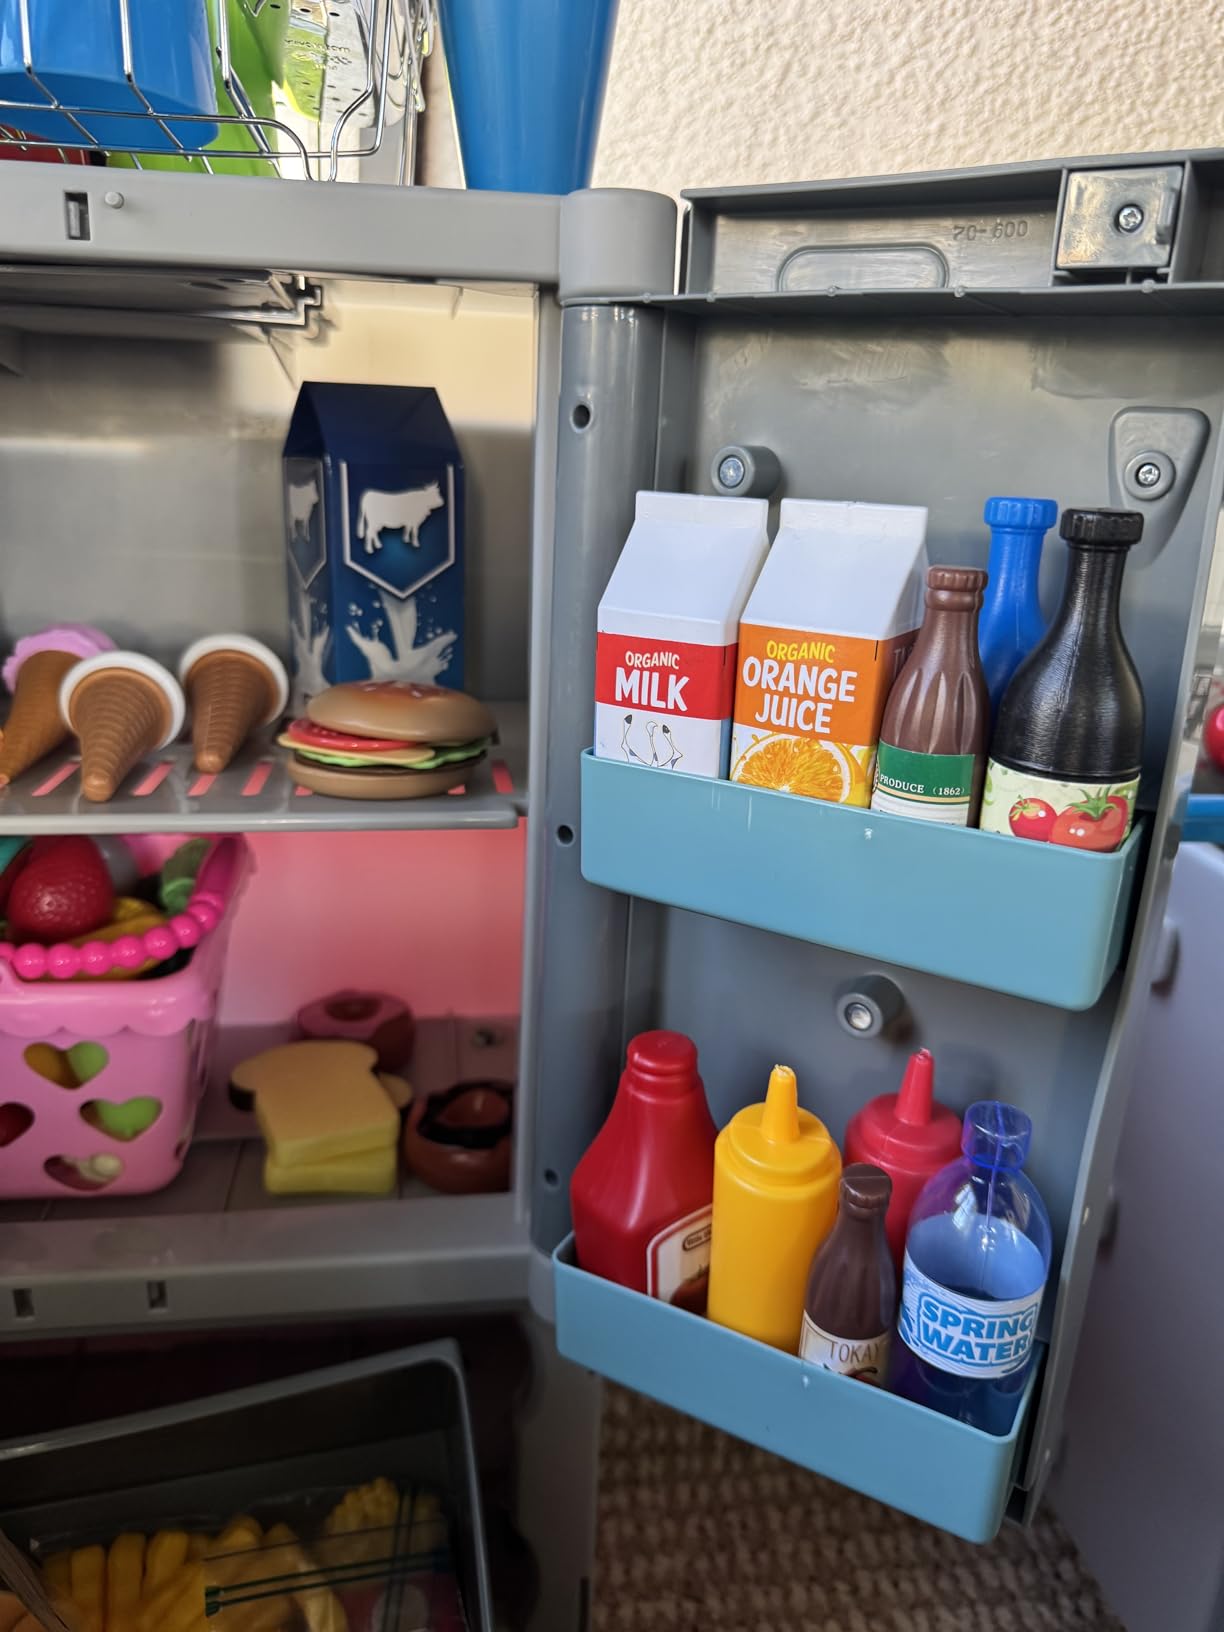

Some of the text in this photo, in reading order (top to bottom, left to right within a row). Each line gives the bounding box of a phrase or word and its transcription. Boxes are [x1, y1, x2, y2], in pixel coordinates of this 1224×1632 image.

[624, 650, 680, 670] ORGANIC
[766, 640, 836, 664] ORGANIC
[614, 666, 690, 712] MILK
[742, 656, 858, 703] ORANGE
[754, 693, 833, 734] JUICE
[879, 773, 925, 794] PRODUCE
[921, 1301, 1034, 1340] SPRING
[922, 1323, 1031, 1361] WATER
